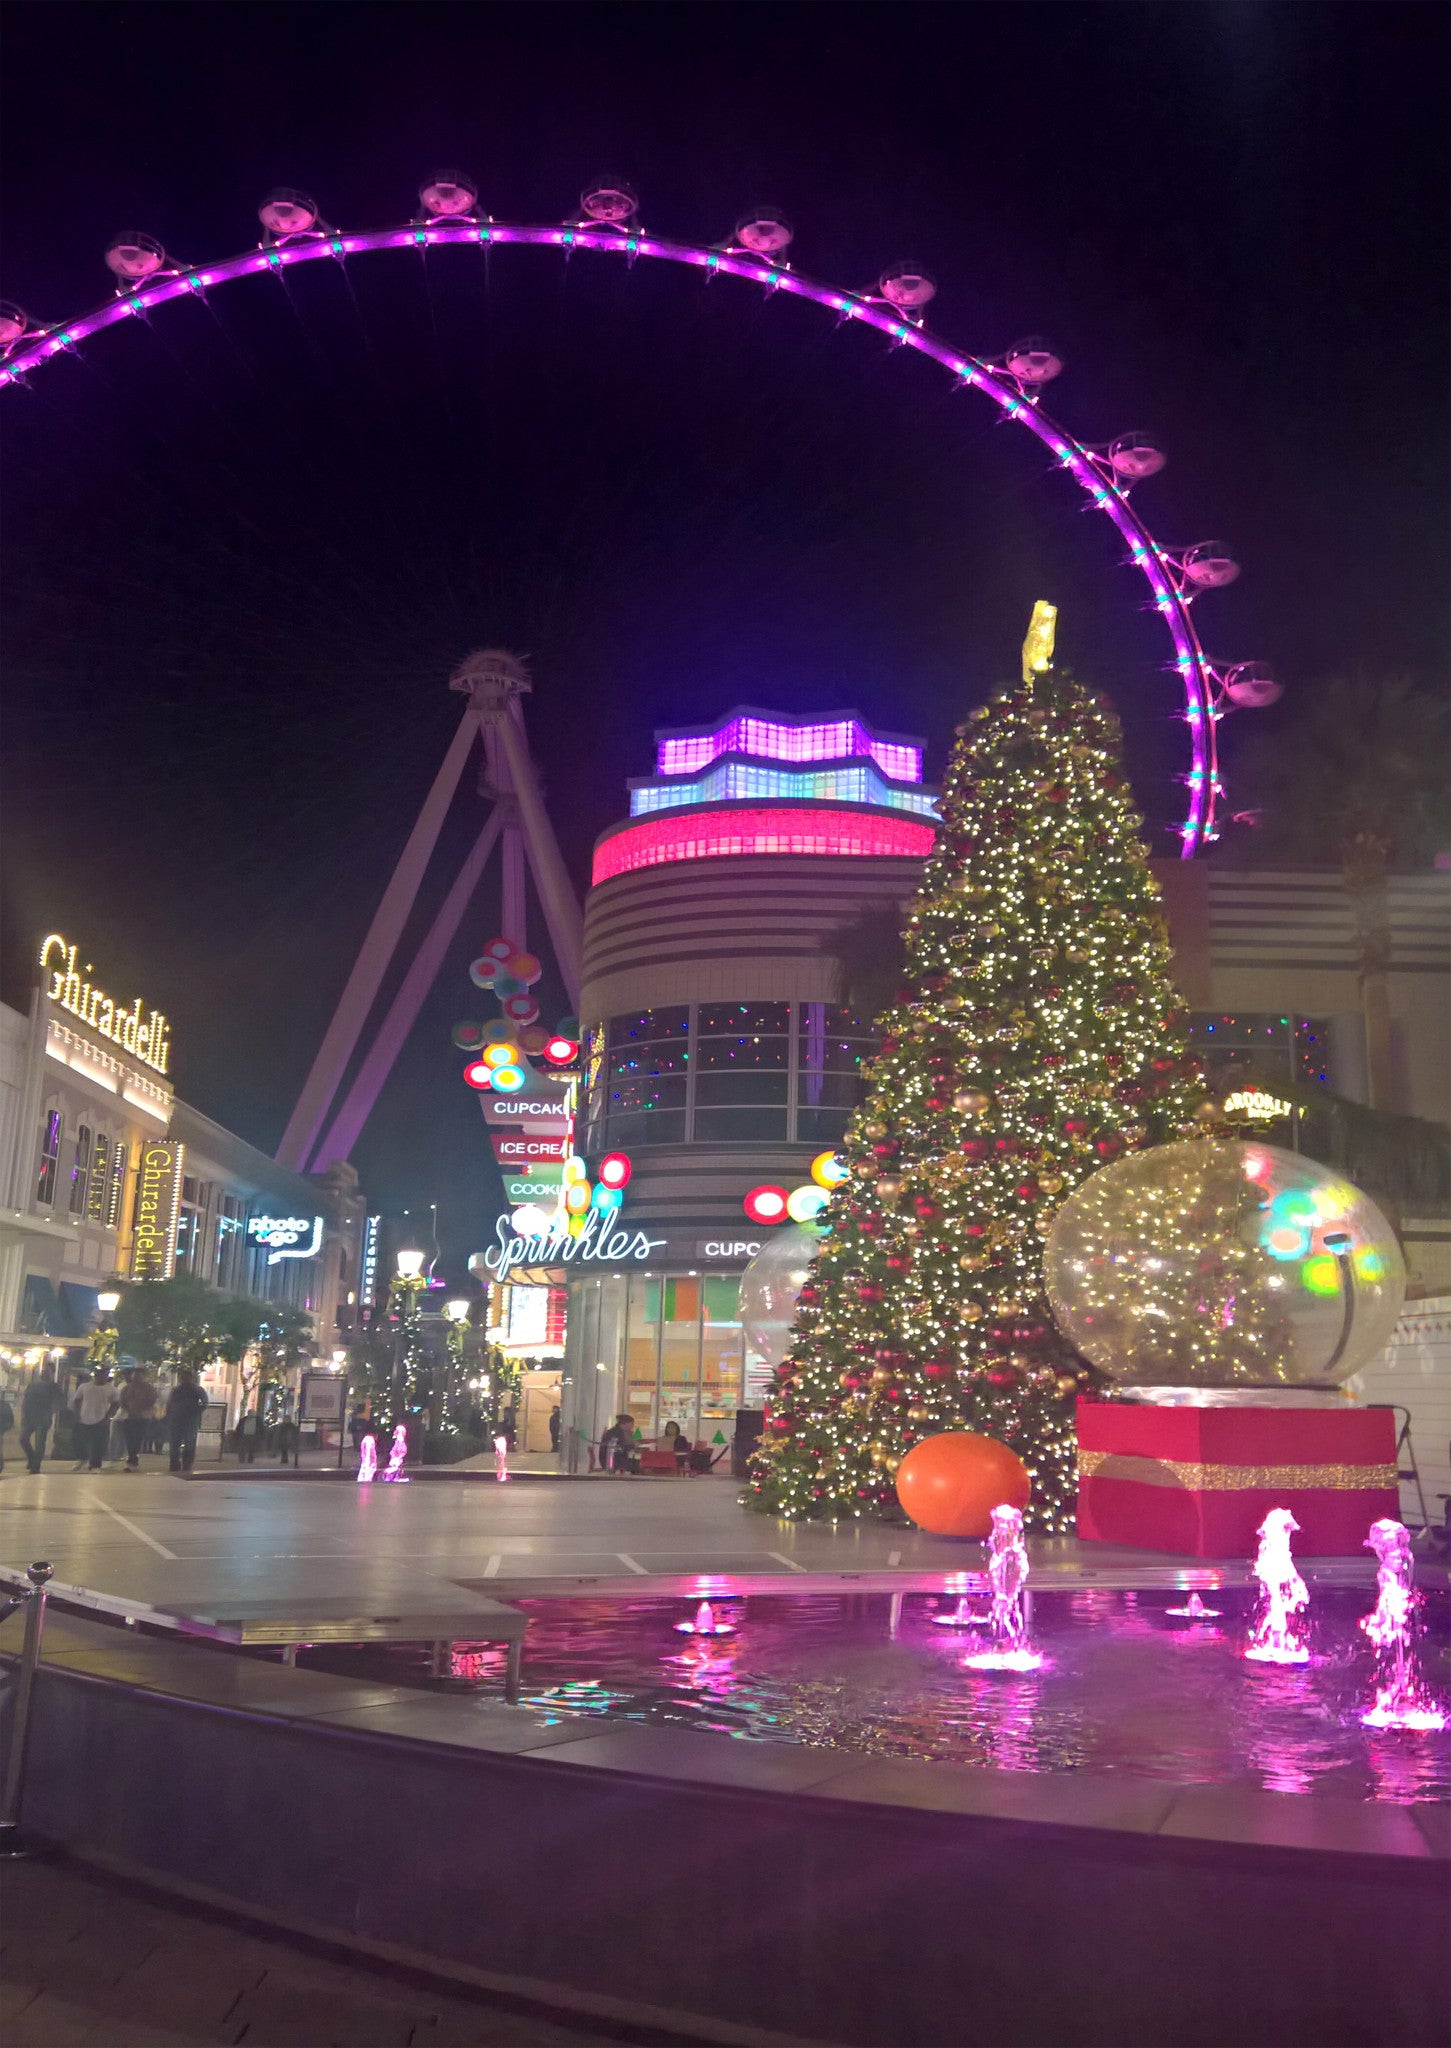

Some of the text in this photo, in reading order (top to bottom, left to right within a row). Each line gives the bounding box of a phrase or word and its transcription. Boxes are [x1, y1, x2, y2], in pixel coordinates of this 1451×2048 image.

[39, 934, 171, 1075] Ghirardelli
[493, 1102, 566, 1115] CUPCAK
[1223, 1091, 1305, 1119] BROOKLY
[500, 1142, 526, 1154] ICE
[510, 1183, 563, 1195] COOKI
[134, 1149, 172, 1272] Ghirardelli
[248, 1215, 309, 1234] photo
[484, 1206, 667, 1283] Sprinkles
[704, 1242, 761, 1257] CUPC
